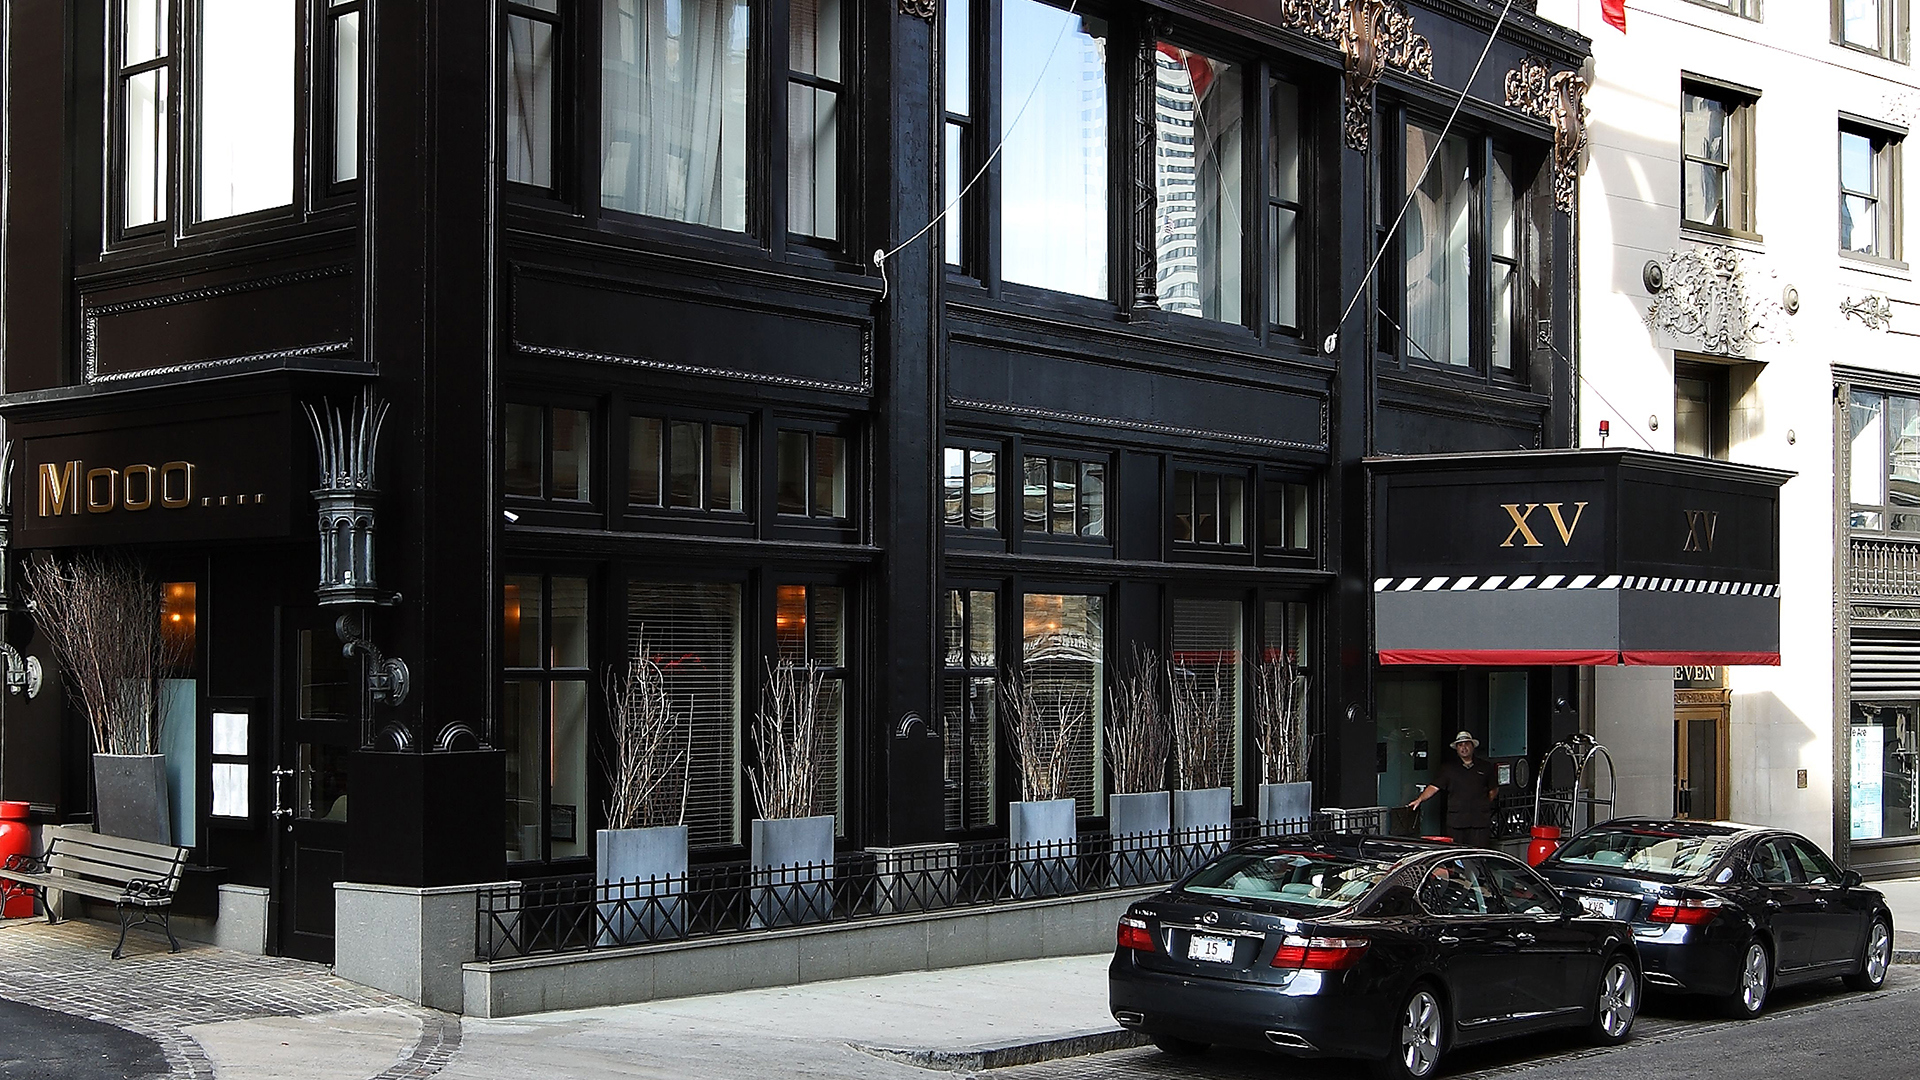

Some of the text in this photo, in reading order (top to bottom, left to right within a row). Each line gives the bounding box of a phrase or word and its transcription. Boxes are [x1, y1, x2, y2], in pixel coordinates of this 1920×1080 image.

[1500, 501, 1588, 547] XV
[1683, 509, 1719, 551] XV
[1673, 665, 1716, 680] EVEN
[1204, 941, 1219, 956] 15
